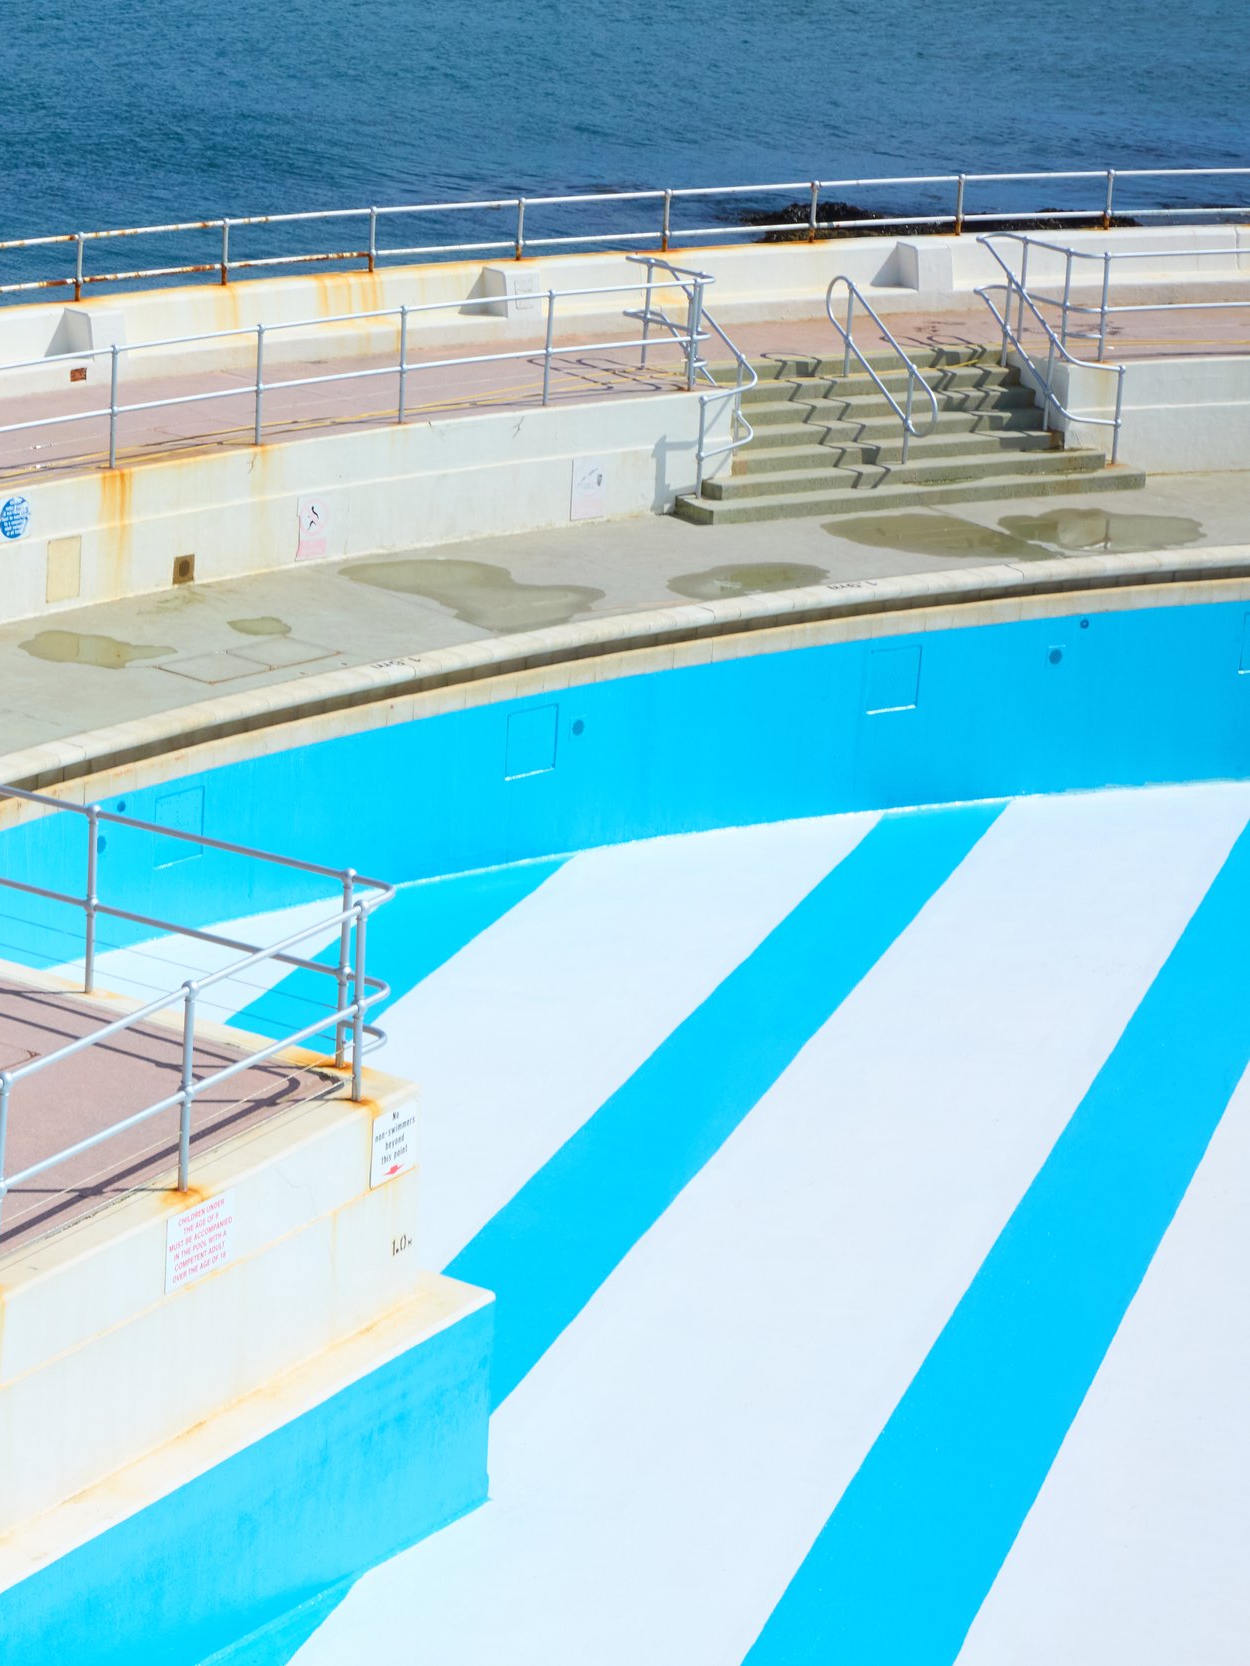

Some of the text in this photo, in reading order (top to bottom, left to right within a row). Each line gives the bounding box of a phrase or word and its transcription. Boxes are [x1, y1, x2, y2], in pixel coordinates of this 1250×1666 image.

[374, 1116, 416, 1143] non-swimmers
[392, 1111, 400, 1121] No
[381, 1143, 408, 1165] this point
[385, 1132, 405, 1151] beyond
[178, 1198, 225, 1227] CHILDREN UNDER
[183, 1224, 194, 1235] THE
[195, 1217, 206, 1229] AGE
[206, 1213, 215, 1223] OF
[168, 1216, 233, 1253] MUST BE ACCOMPANIED
[173, 1253, 180, 1262] IN
[181, 1247, 191, 1258] THE
[192, 1240, 207, 1253] POOL
[208, 1232, 222, 1245] WITH
[172, 1270, 188, 1284] OVER
[188, 1264, 198, 1275] THE
[199, 1259, 210, 1270] AGE
[211, 1254, 219, 1264] OF
[174, 1240, 226, 1273] COMPETENT ADULT
